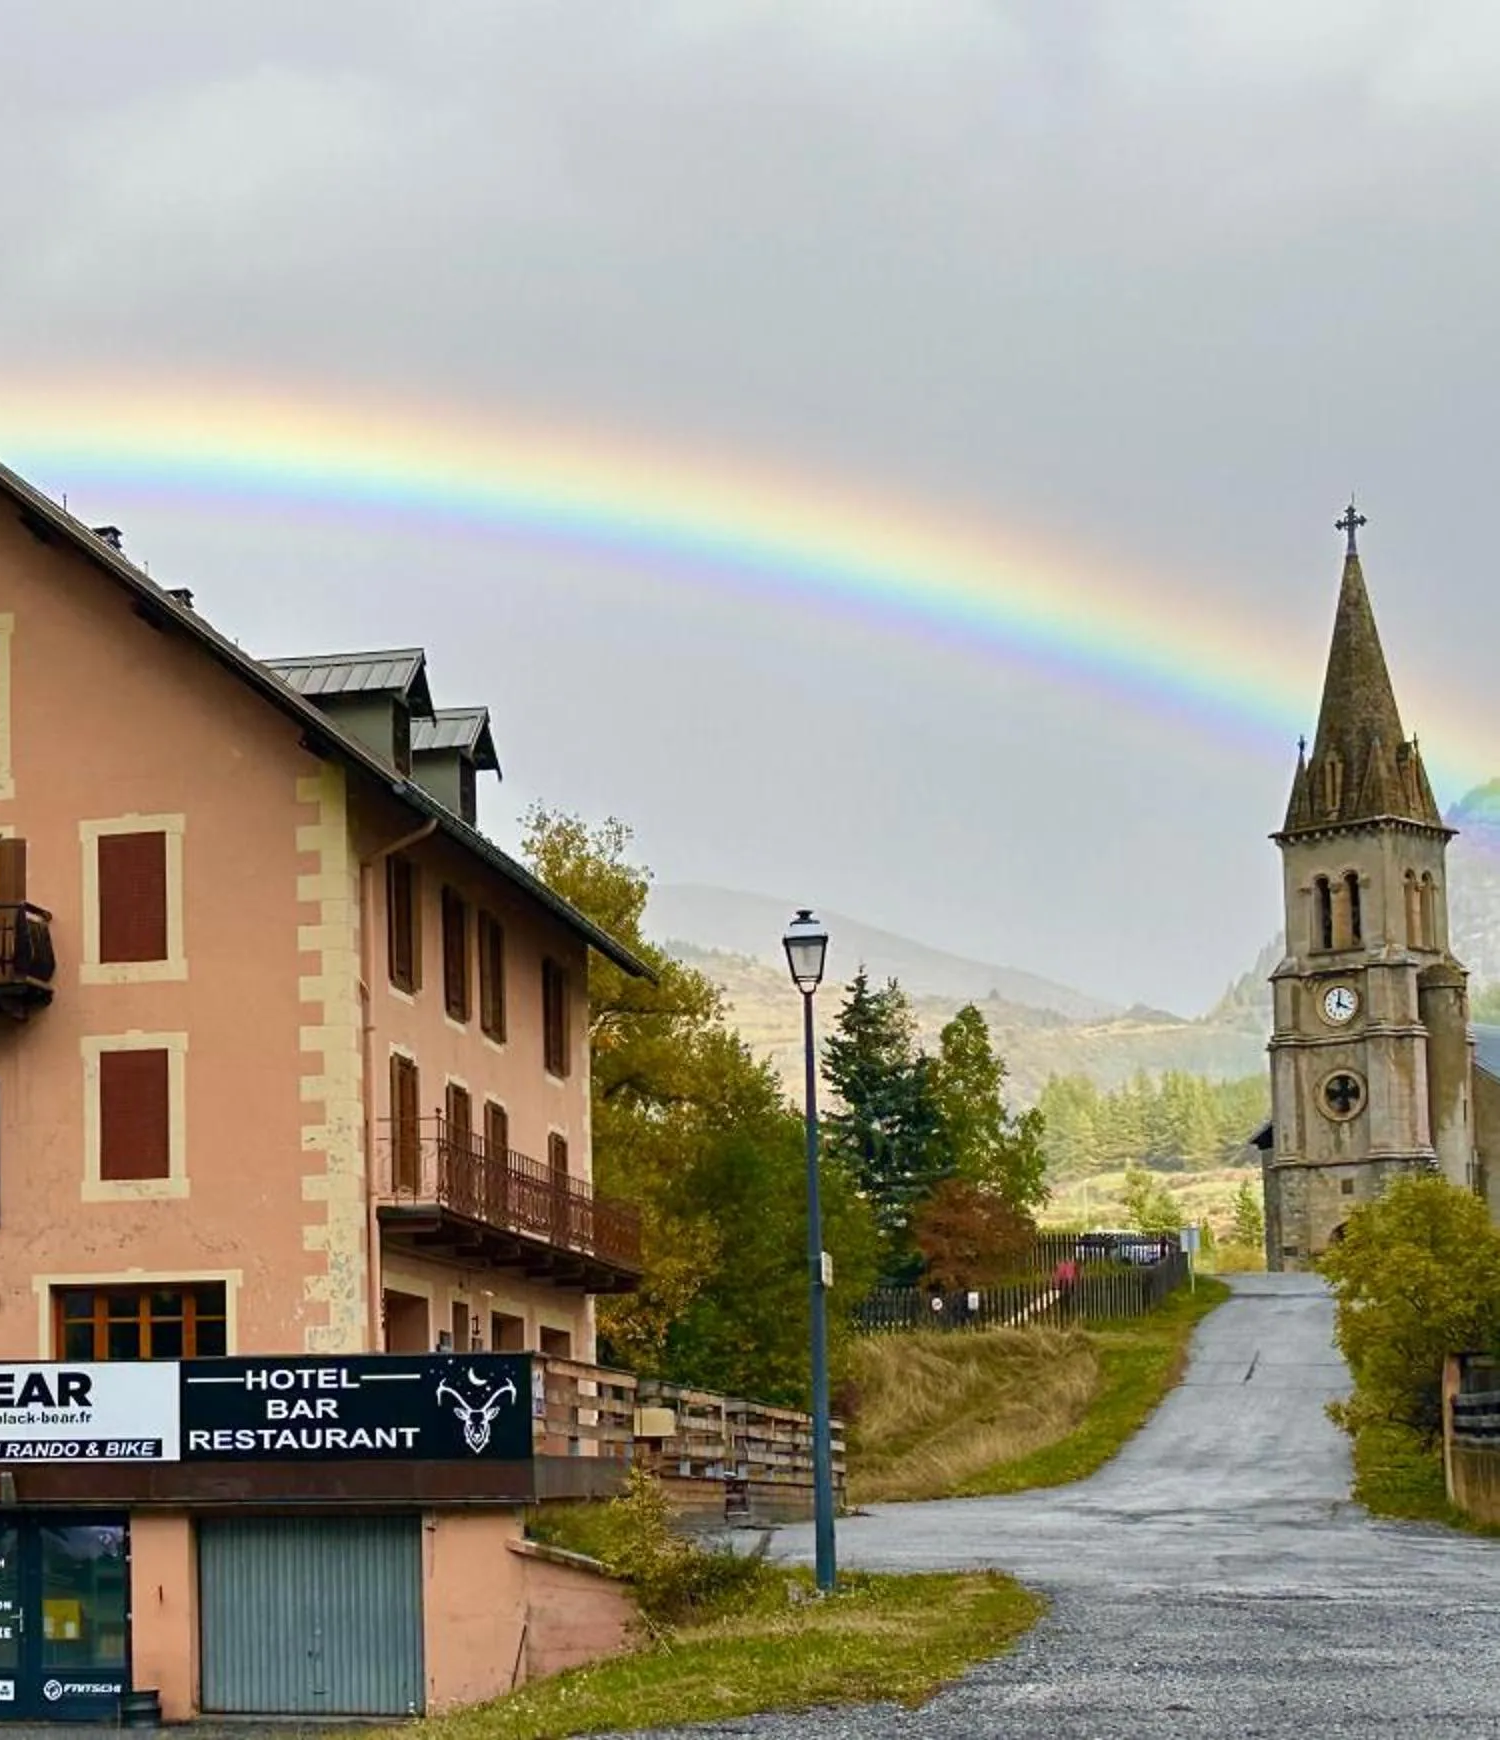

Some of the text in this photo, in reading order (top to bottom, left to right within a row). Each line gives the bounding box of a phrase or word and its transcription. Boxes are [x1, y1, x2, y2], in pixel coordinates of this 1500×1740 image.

[245, 1367, 361, 1391] HOTEL
[266, 1399, 339, 1420] BAR
[5, 1442, 80, 1457] RANDO
[85, 1441, 100, 1456] &
[105, 1441, 156, 1456] BIKE
[188, 1427, 421, 1451] RESTAURANT
